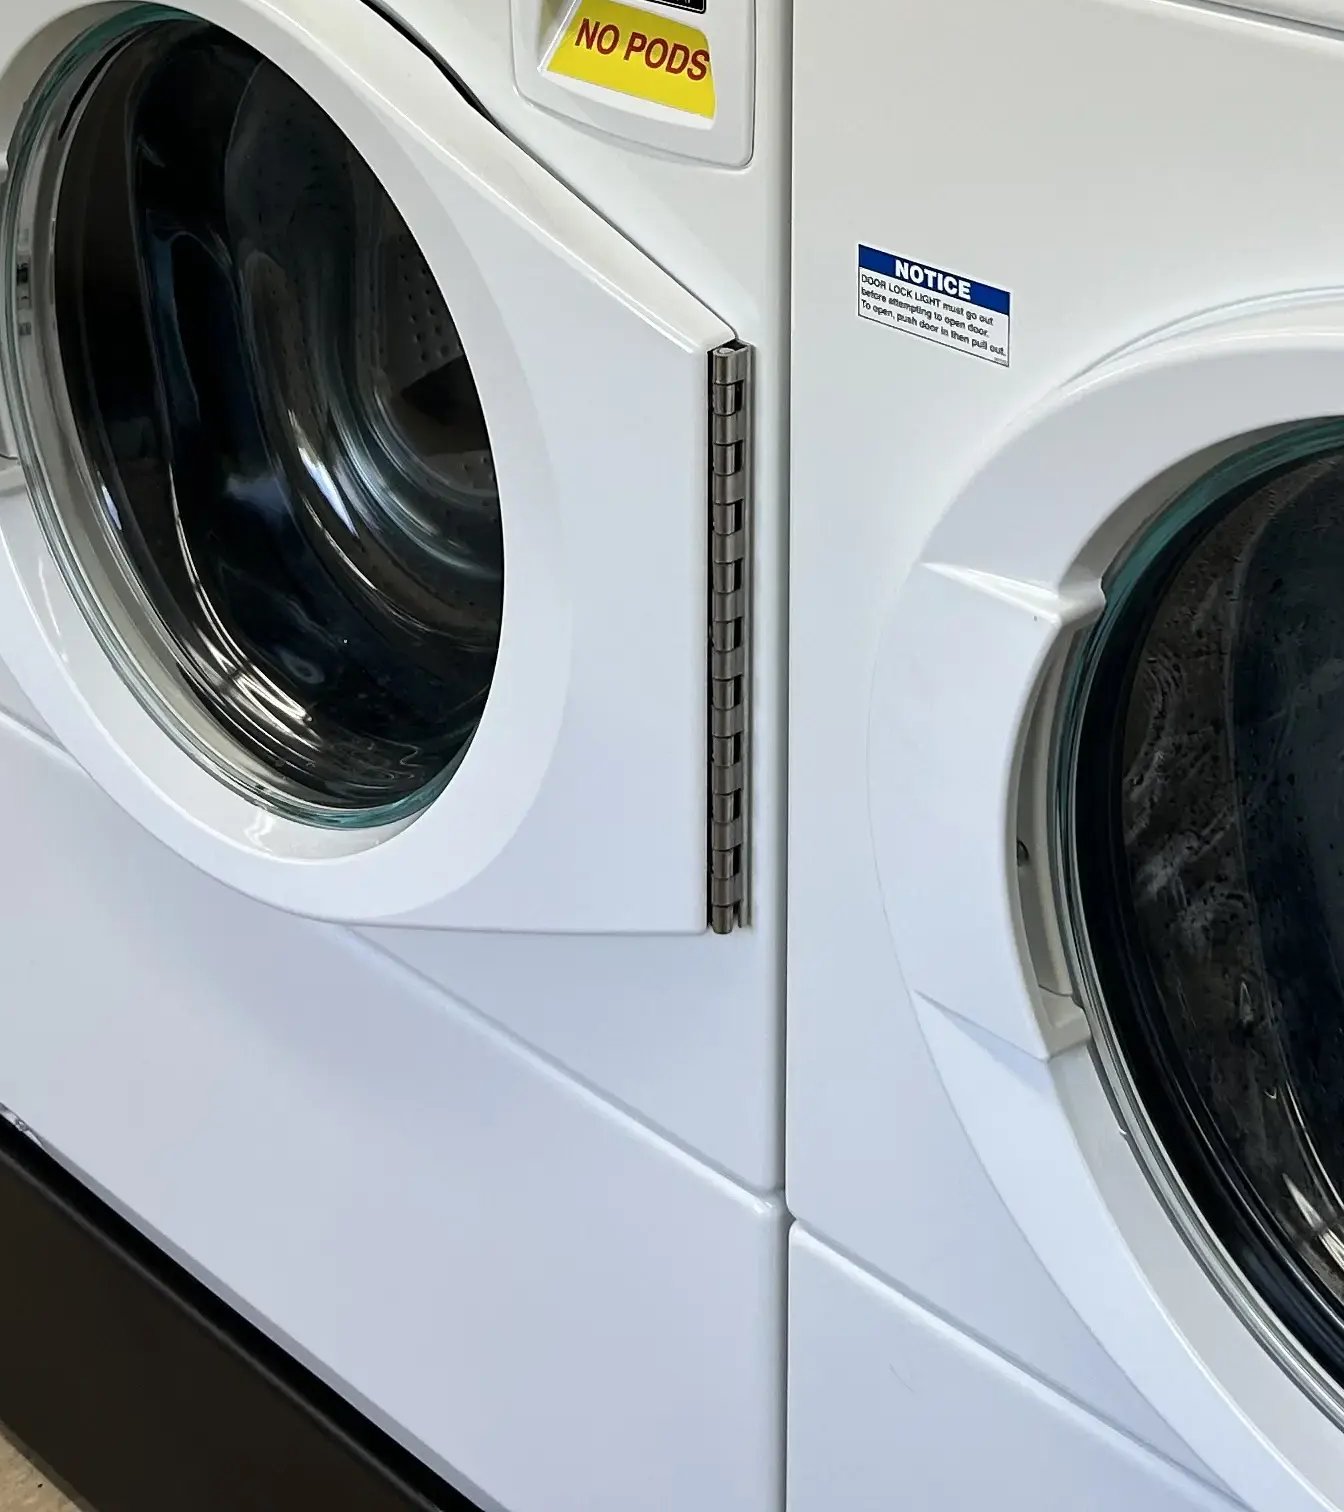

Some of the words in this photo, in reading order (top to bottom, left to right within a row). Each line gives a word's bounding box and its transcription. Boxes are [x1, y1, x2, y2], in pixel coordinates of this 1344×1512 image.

[574, 17, 620, 56] NO
[622, 30, 710, 81] PODS
[861, 274, 887, 289] DOOR
[887, 282, 913, 299] LOCK
[914, 291, 941, 308] LIGHT
[942, 302, 964, 317] must
[965, 310, 978, 322] go
[978, 315, 994, 327] out
[894, 259, 971, 300] NOTICE
[861, 286, 887, 303] before
[888, 297, 932, 320] attempting
[933, 311, 943, 322] to
[944, 316, 966, 330] open
[967, 324, 990, 338] door.
[861, 298, 871, 311] To
[872, 305, 896, 320] open,
[896, 312, 918, 327] push
[919, 319, 939, 333] door
[940, 325, 949, 337] in
[950, 329, 970, 345] then
[971, 339, 988, 350] pull
[989, 344, 1007, 357] out.
